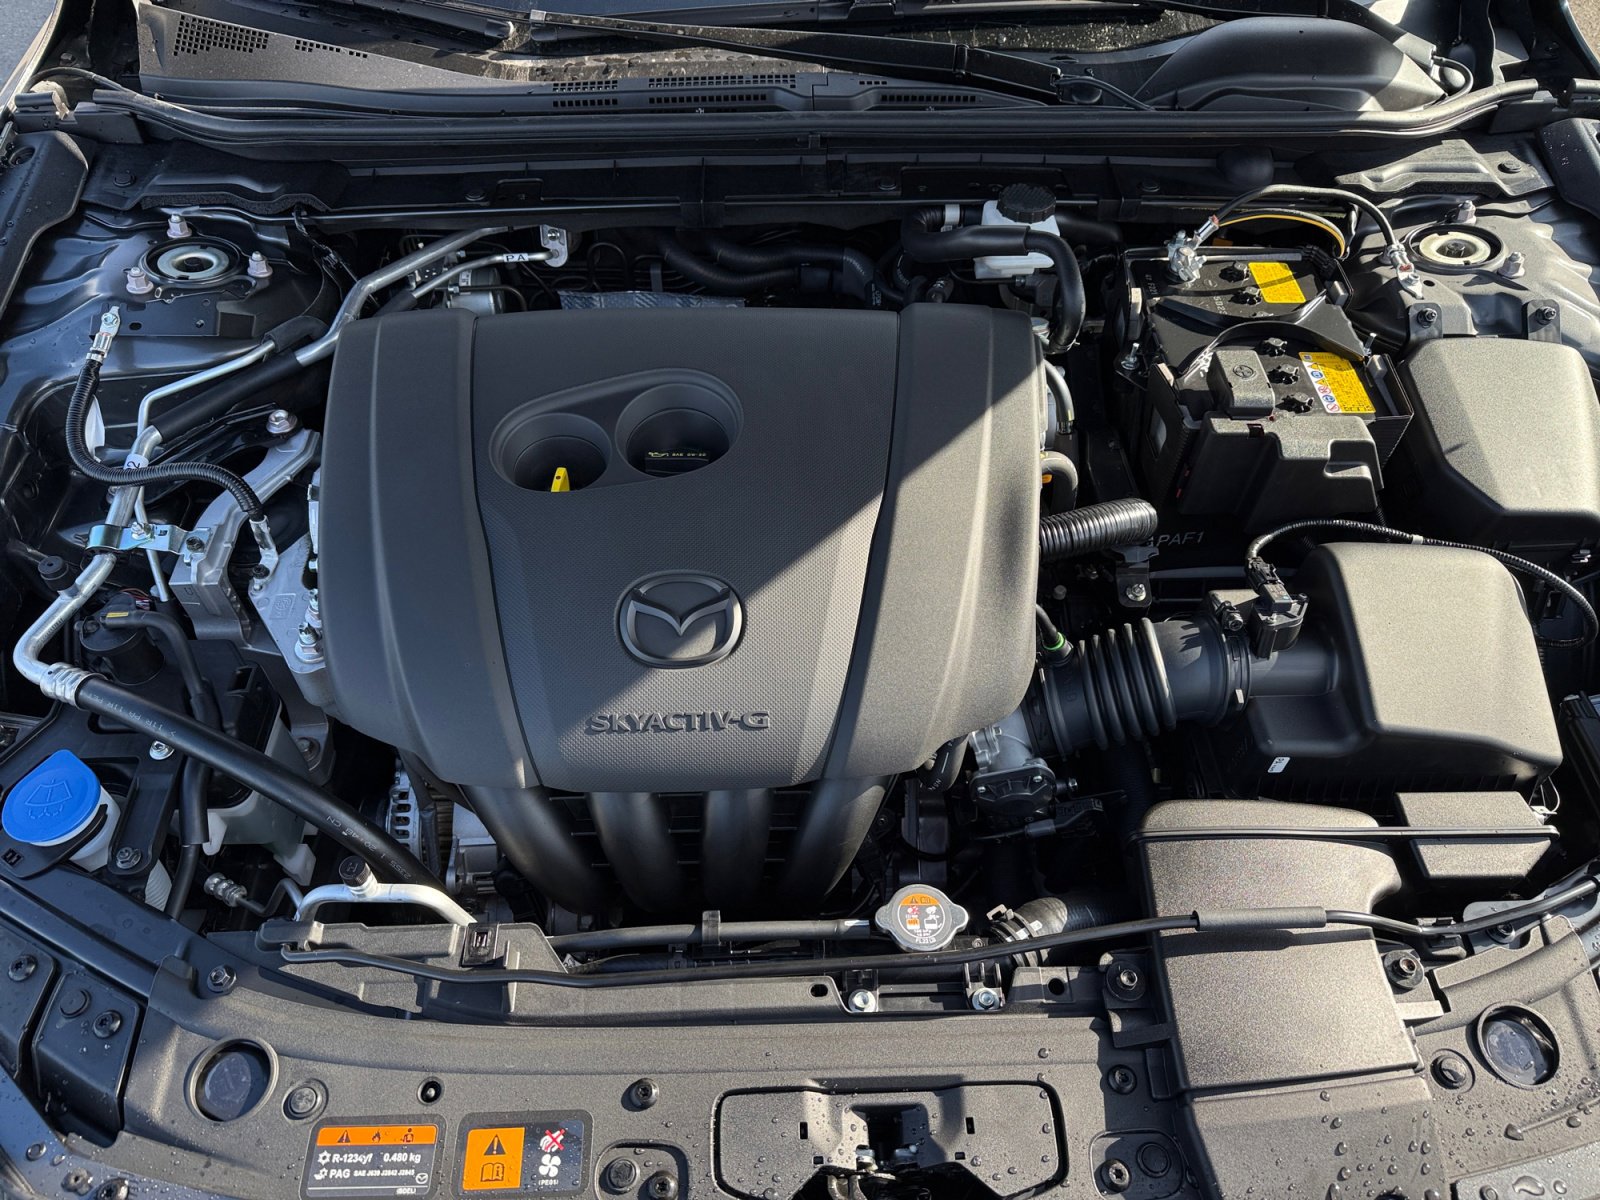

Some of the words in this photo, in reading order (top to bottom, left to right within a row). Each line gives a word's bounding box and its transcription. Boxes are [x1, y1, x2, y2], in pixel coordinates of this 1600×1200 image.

[589, 709, 770, 732] SKYACTIV-G
[383, 1152, 408, 1163] 0.480
[409, 1152, 421, 1164] kg
[329, 1168, 351, 1179] PAG
